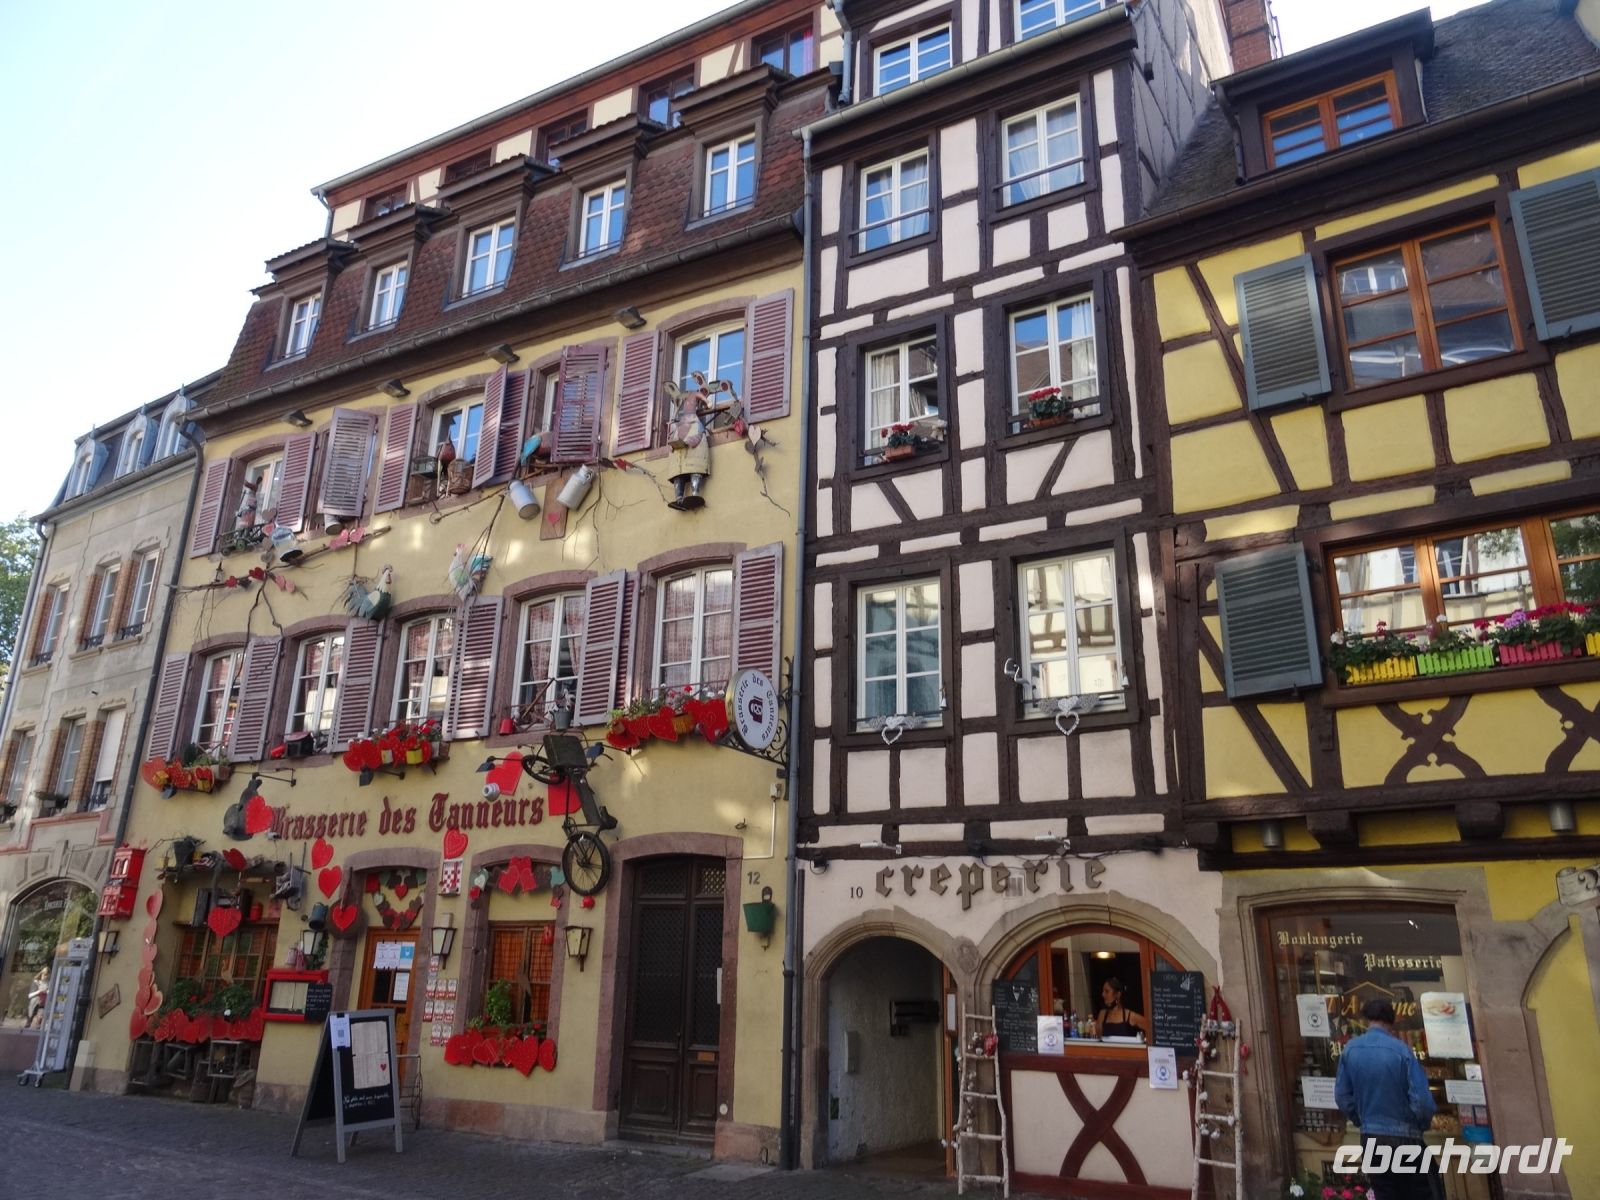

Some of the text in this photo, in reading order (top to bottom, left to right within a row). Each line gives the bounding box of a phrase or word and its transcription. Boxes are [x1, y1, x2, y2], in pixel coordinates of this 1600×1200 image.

[738, 673, 775, 742] Brasserie des Tanneurs
[271, 792, 544, 840] Brasserie des Tanneurs
[747, 871, 760, 885] 12
[875, 859, 1107, 911] creperie
[850, 886, 864, 899] 10
[1277, 931, 1363, 948] Boulangerie
[1363, 953, 1442, 971] Patisserie
